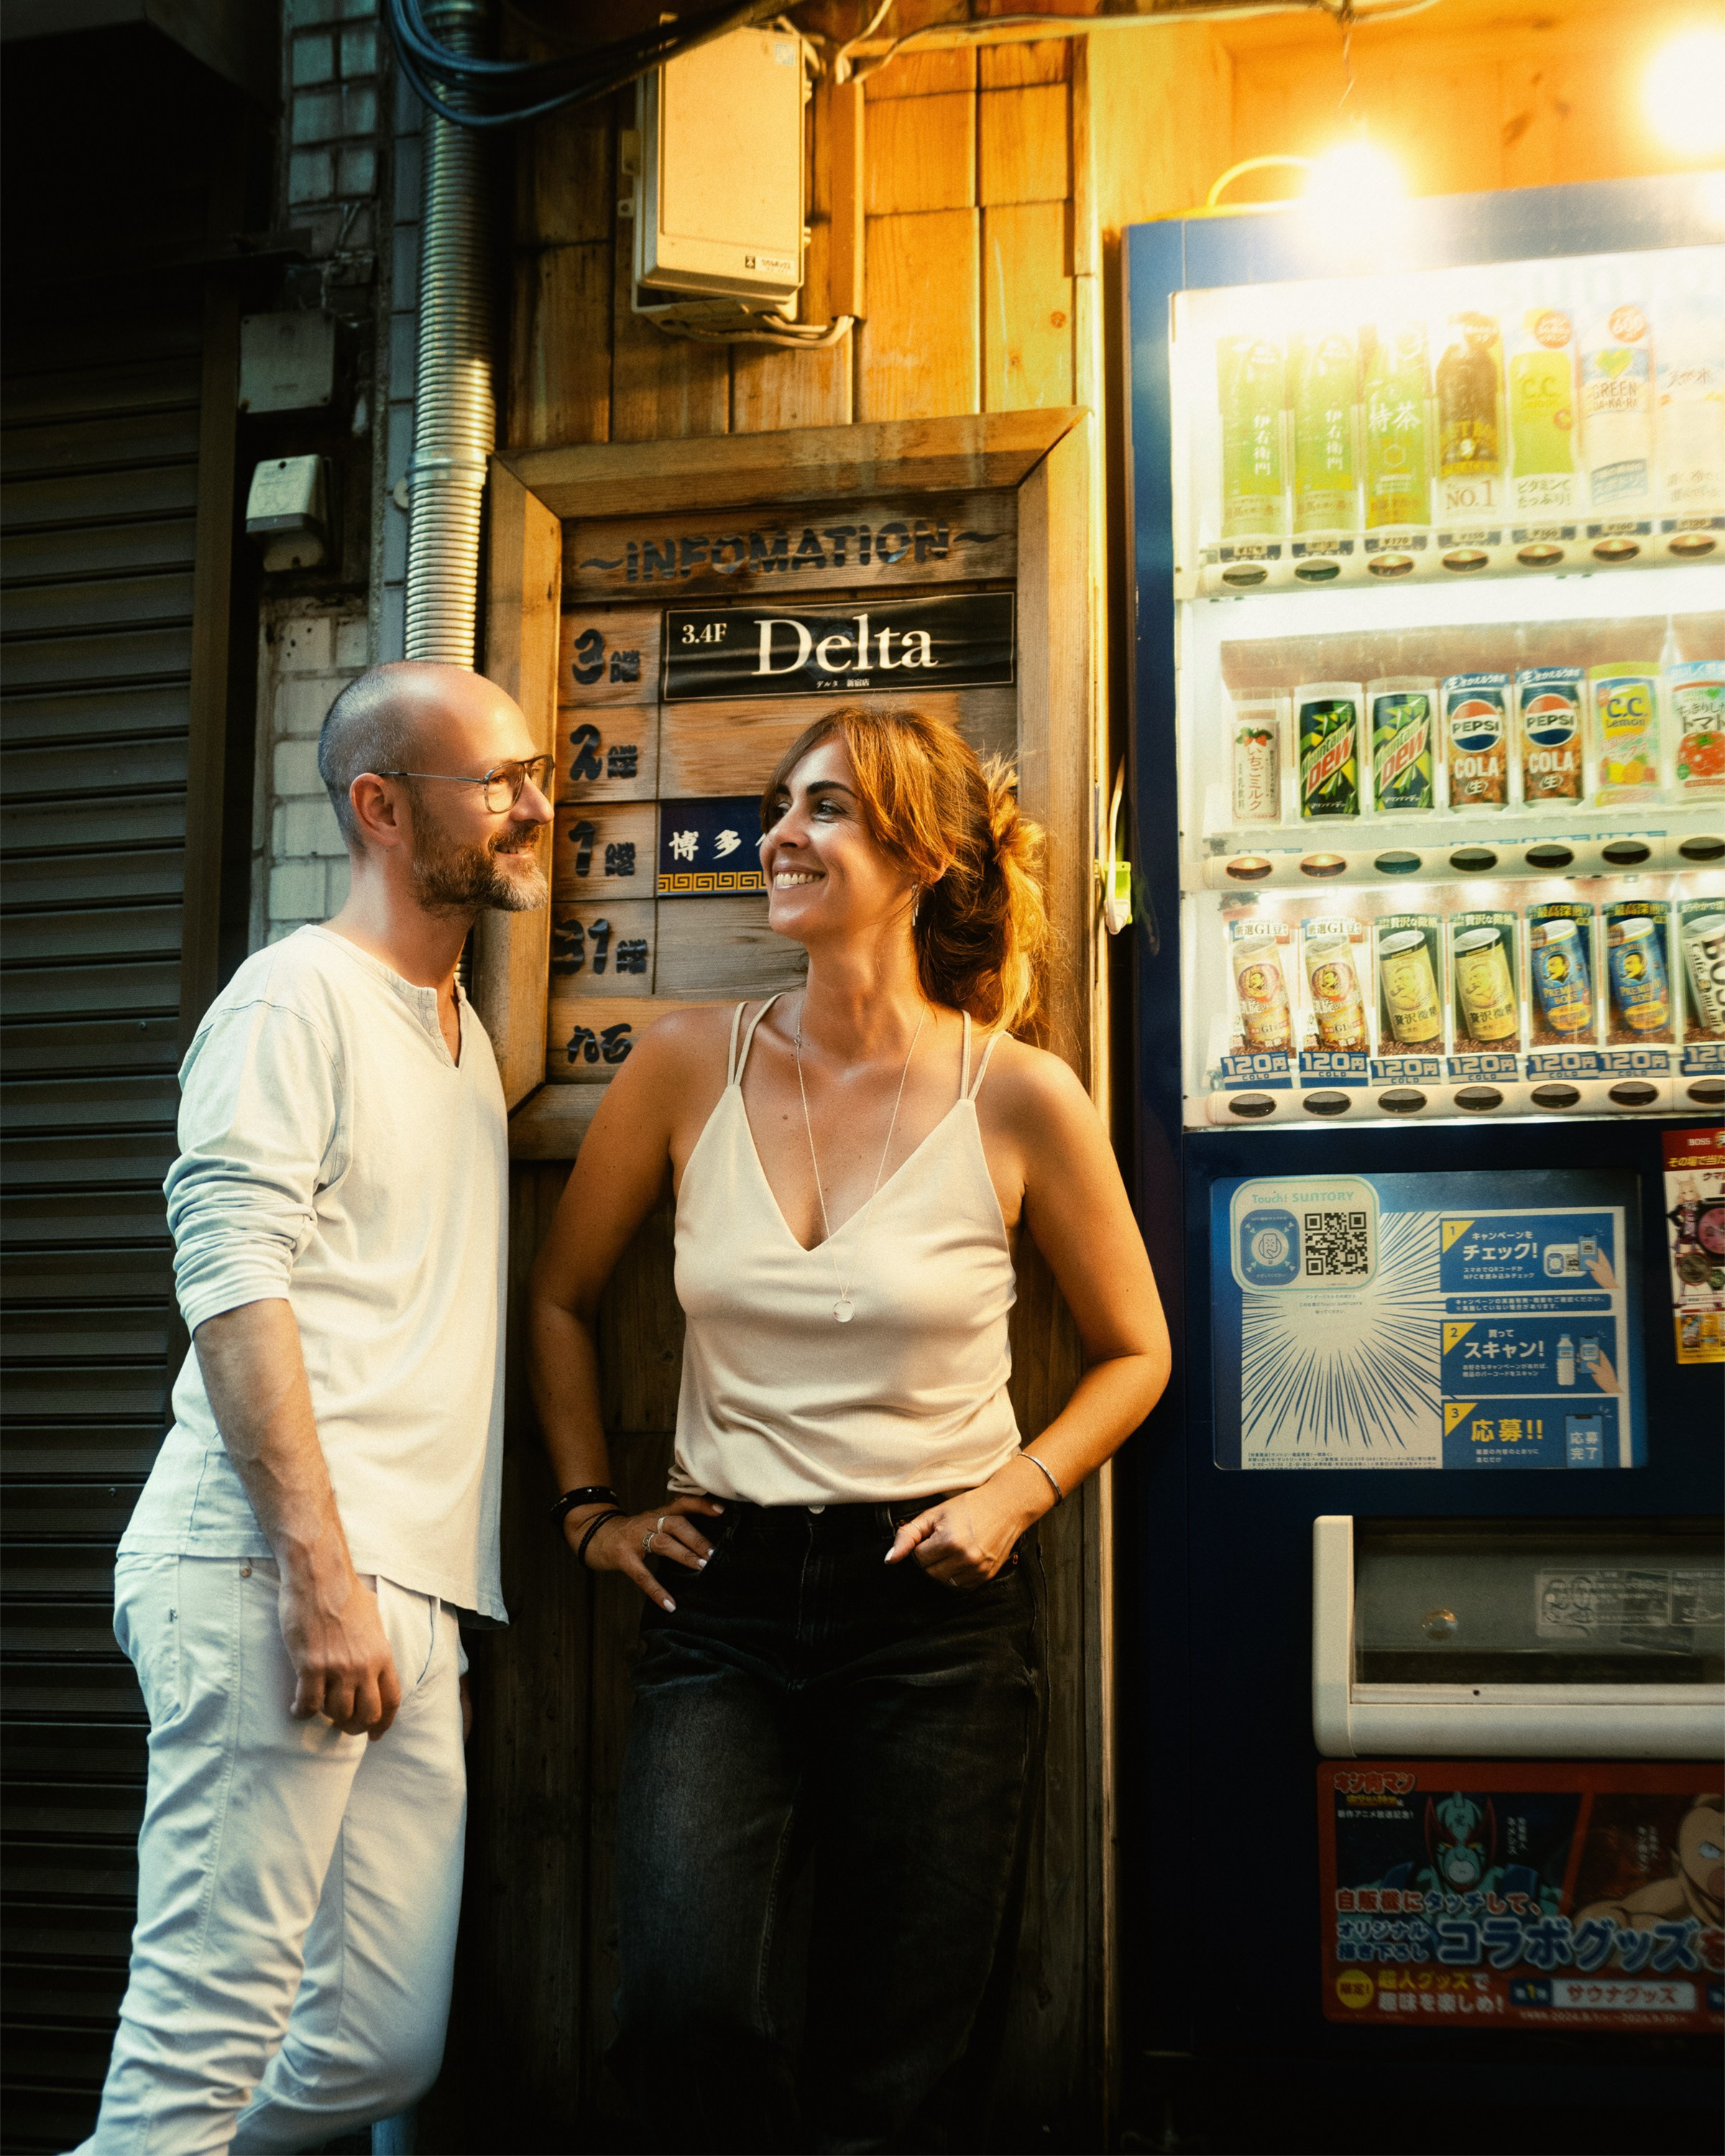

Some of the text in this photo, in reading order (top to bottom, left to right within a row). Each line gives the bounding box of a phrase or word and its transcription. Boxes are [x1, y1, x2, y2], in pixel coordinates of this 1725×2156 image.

[1591, 379, 1638, 400] GREEN
[1367, 400, 1423, 433] 特茶
[1254, 413, 1271, 476] 伊右衛門
[1325, 408, 1343, 471] 伊右衛門
[681, 622, 728, 646] 3.4F
[753, 613, 941, 676] Delta
[1453, 720, 1499, 734] PEPSI
[1527, 714, 1574, 728] PEPSI
[1606, 718, 1646, 728] Lemon
[1454, 757, 1499, 779] COLA
[1529, 750, 1574, 773] COLA
[1248, 747, 1264, 811] いちごミルク
[669, 829, 768, 863] 博多
[1223, 1053, 1287, 1074] 120円
[1302, 1053, 1366, 1071] 120円
[1373, 1059, 1438, 1077] 120円
[1450, 1054, 1514, 1074] 120円
[1531, 1052, 1597, 1072] 120円
[1601, 1051, 1668, 1070] 120円
[1252, 1193, 1288, 1205] Touch!
[1450, 1225, 1455, 1236] 1
[1472, 1231, 1533, 1241] キャンペーンを
[1463, 1243, 1537, 1261] チェック!
[1450, 1327, 1458, 1337] 2
[1489, 1329, 1514, 1338] 買って
[1464, 1340, 1545, 1359] スキャン!
[1451, 1407, 1460, 1419] 3
[1471, 1419, 1544, 1442] 応募!!
[1570, 1431, 1598, 1445] 応募
[1570, 1447, 1597, 1460] 完了
[1334, 1770, 1416, 1795] キン肉マン
[1336, 1887, 1542, 1916] 自販機にタッチして、
[1337, 1920, 1430, 1942] オリジナル
[1337, 1942, 1431, 1963] 描き下ろし
[1567, 1984, 1677, 2005] サウナグッズ
